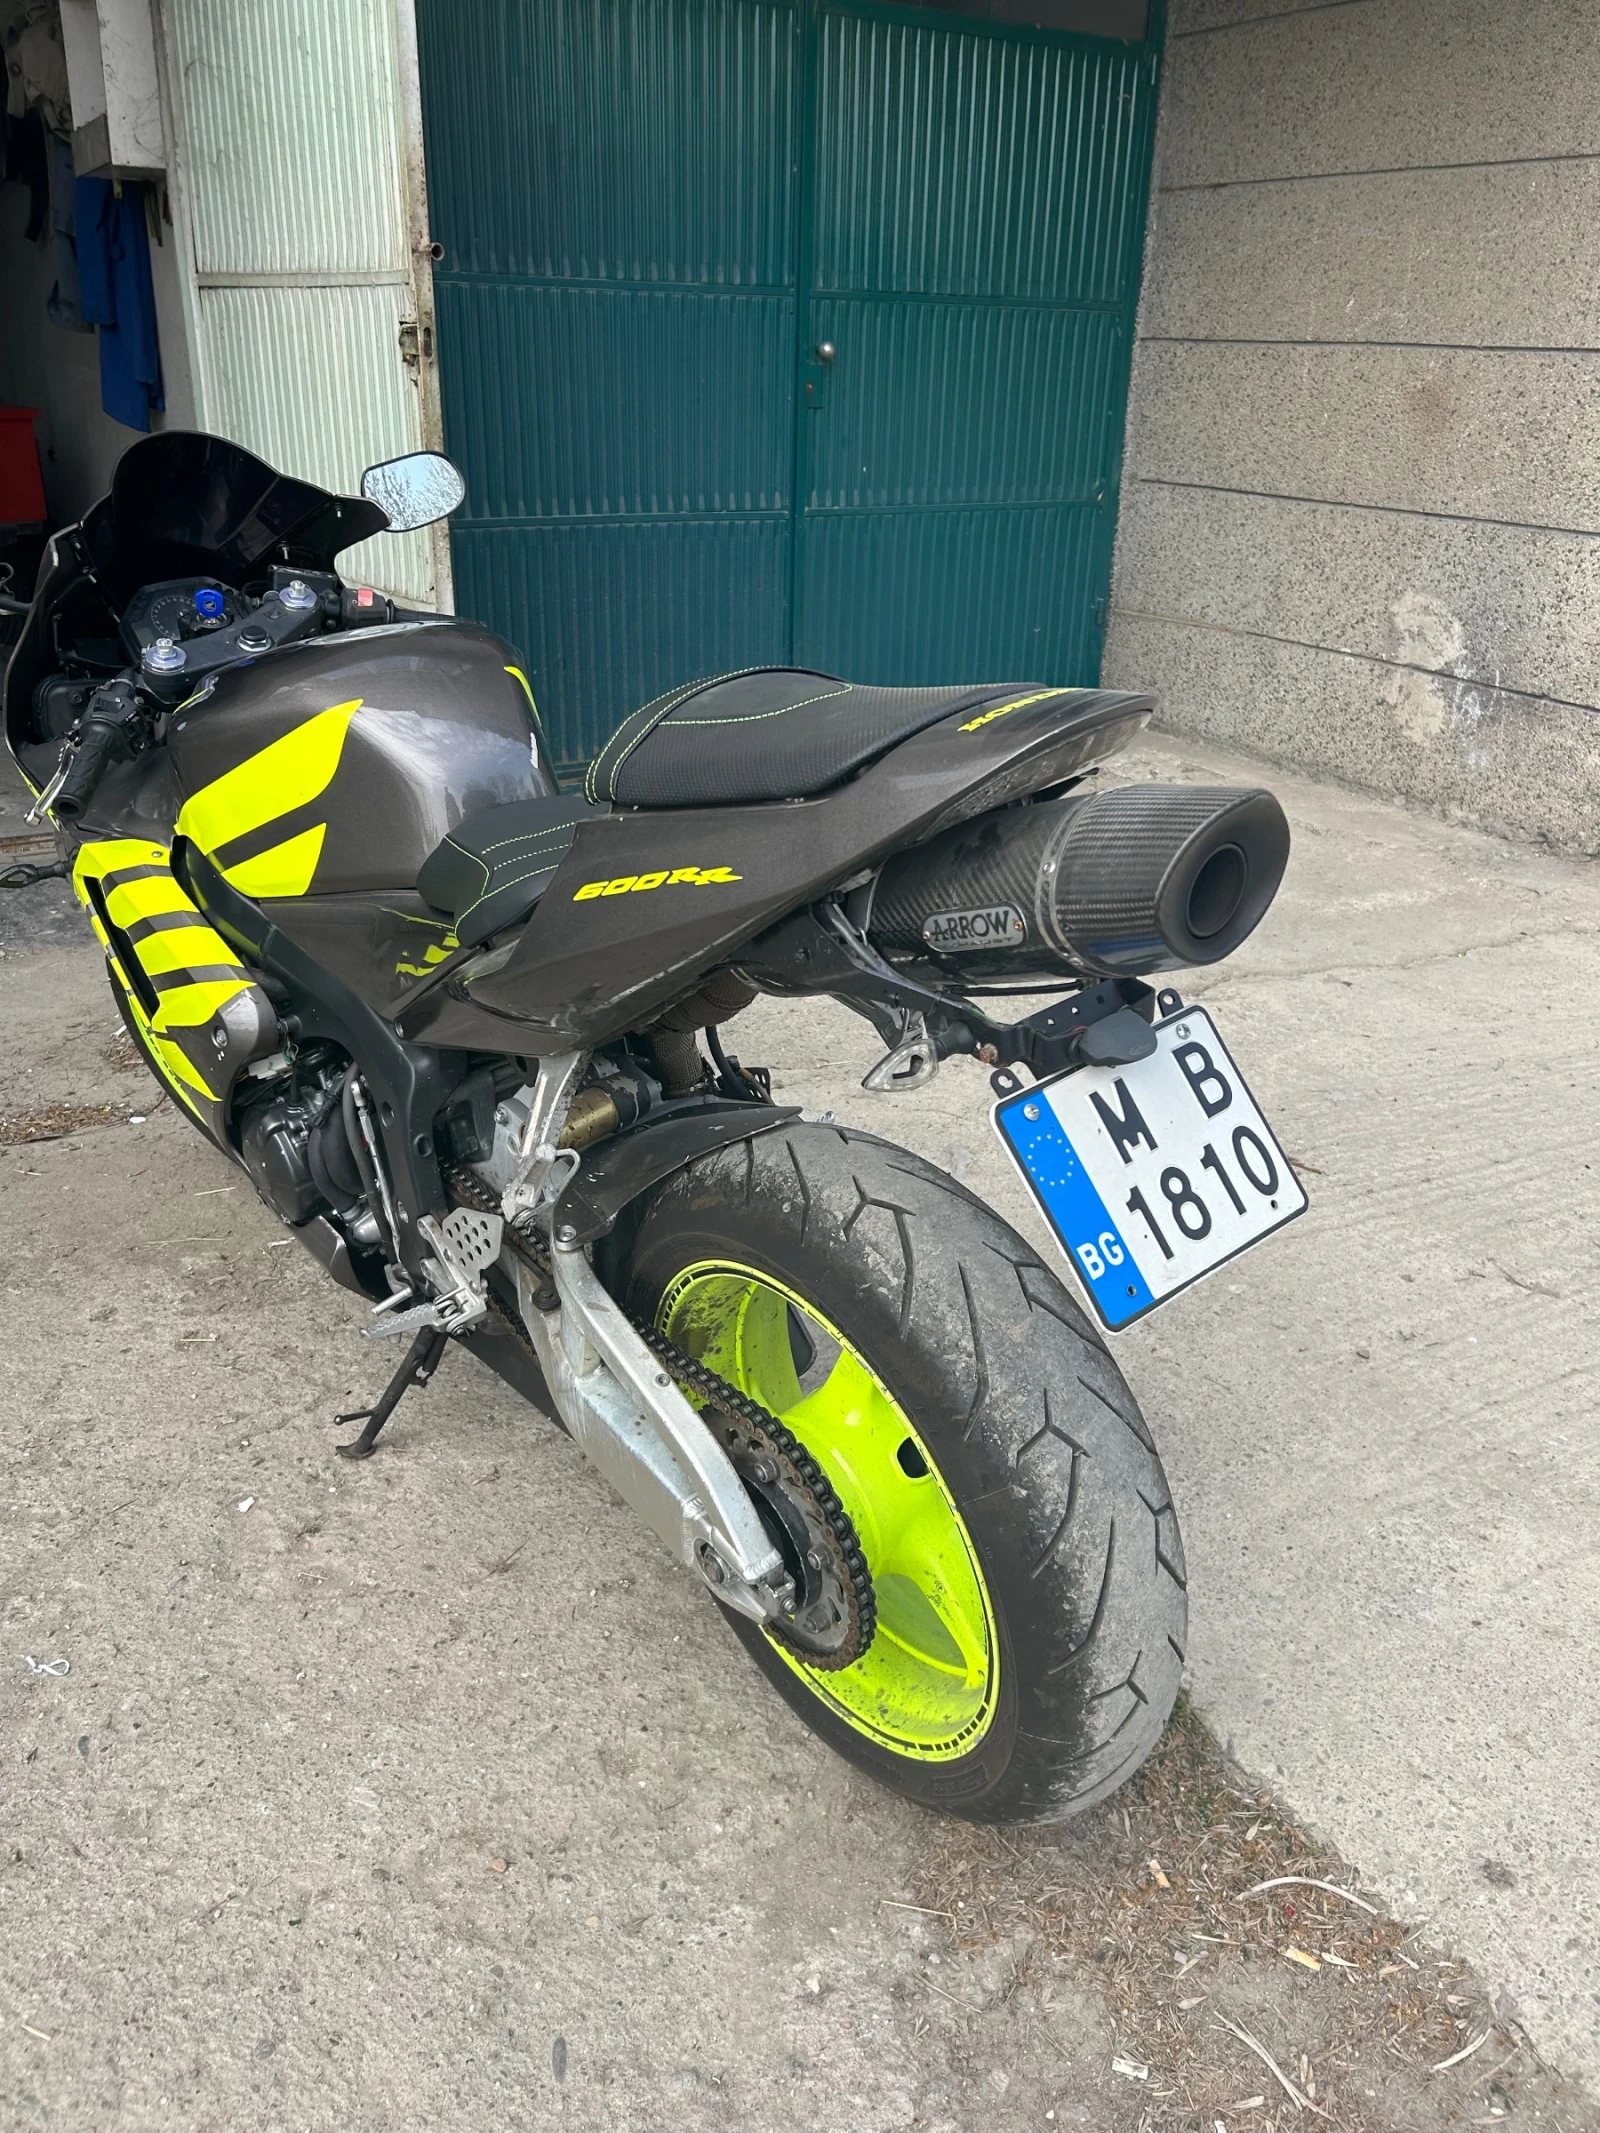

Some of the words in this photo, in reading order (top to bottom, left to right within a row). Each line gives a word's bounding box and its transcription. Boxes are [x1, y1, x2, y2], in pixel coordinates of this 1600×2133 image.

[573, 867, 743, 901] 600RR
[931, 910, 1010, 941] ARROW
[1088, 1078, 1159, 1165] M
[1171, 1041, 1233, 1119] B
[1126, 1126, 1280, 1261] 1810
[1076, 1231, 1125, 1280] BG
